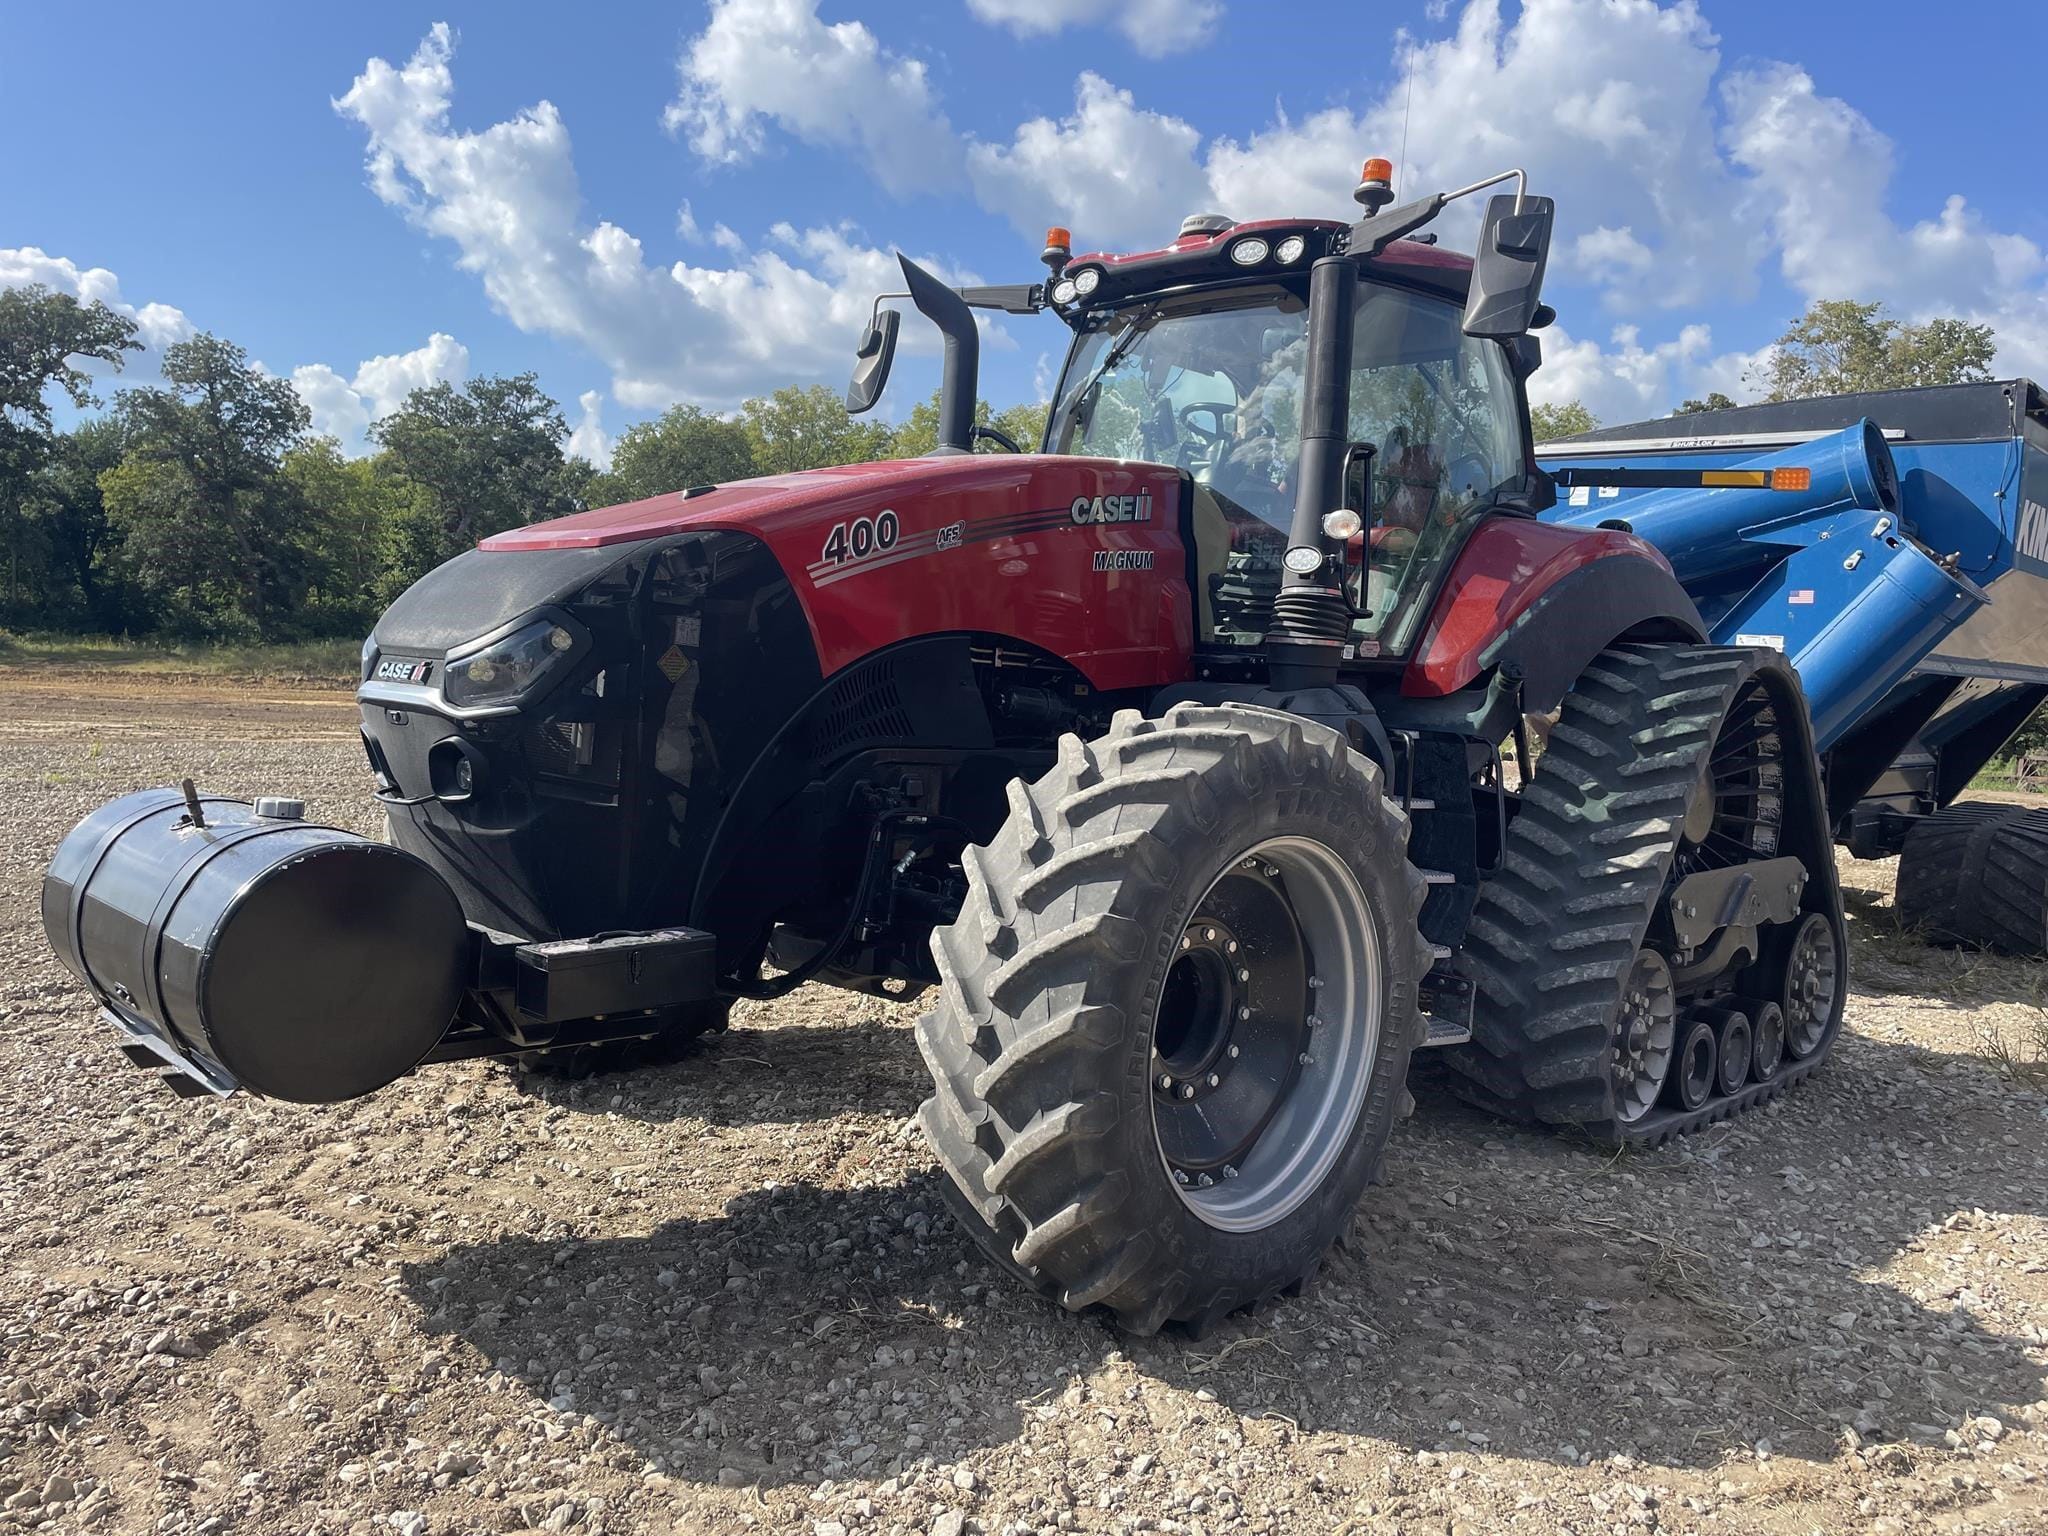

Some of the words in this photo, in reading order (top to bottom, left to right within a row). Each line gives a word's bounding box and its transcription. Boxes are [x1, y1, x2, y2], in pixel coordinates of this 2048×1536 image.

[822, 509, 900, 568] 400
[937, 524, 962, 545] AFS
[2015, 498, 2048, 564] KIN
[1093, 550, 1154, 572] MAGNUM
[378, 662, 412, 679] CASE
[1123, 894, 1189, 1111] TRELLEBORG
